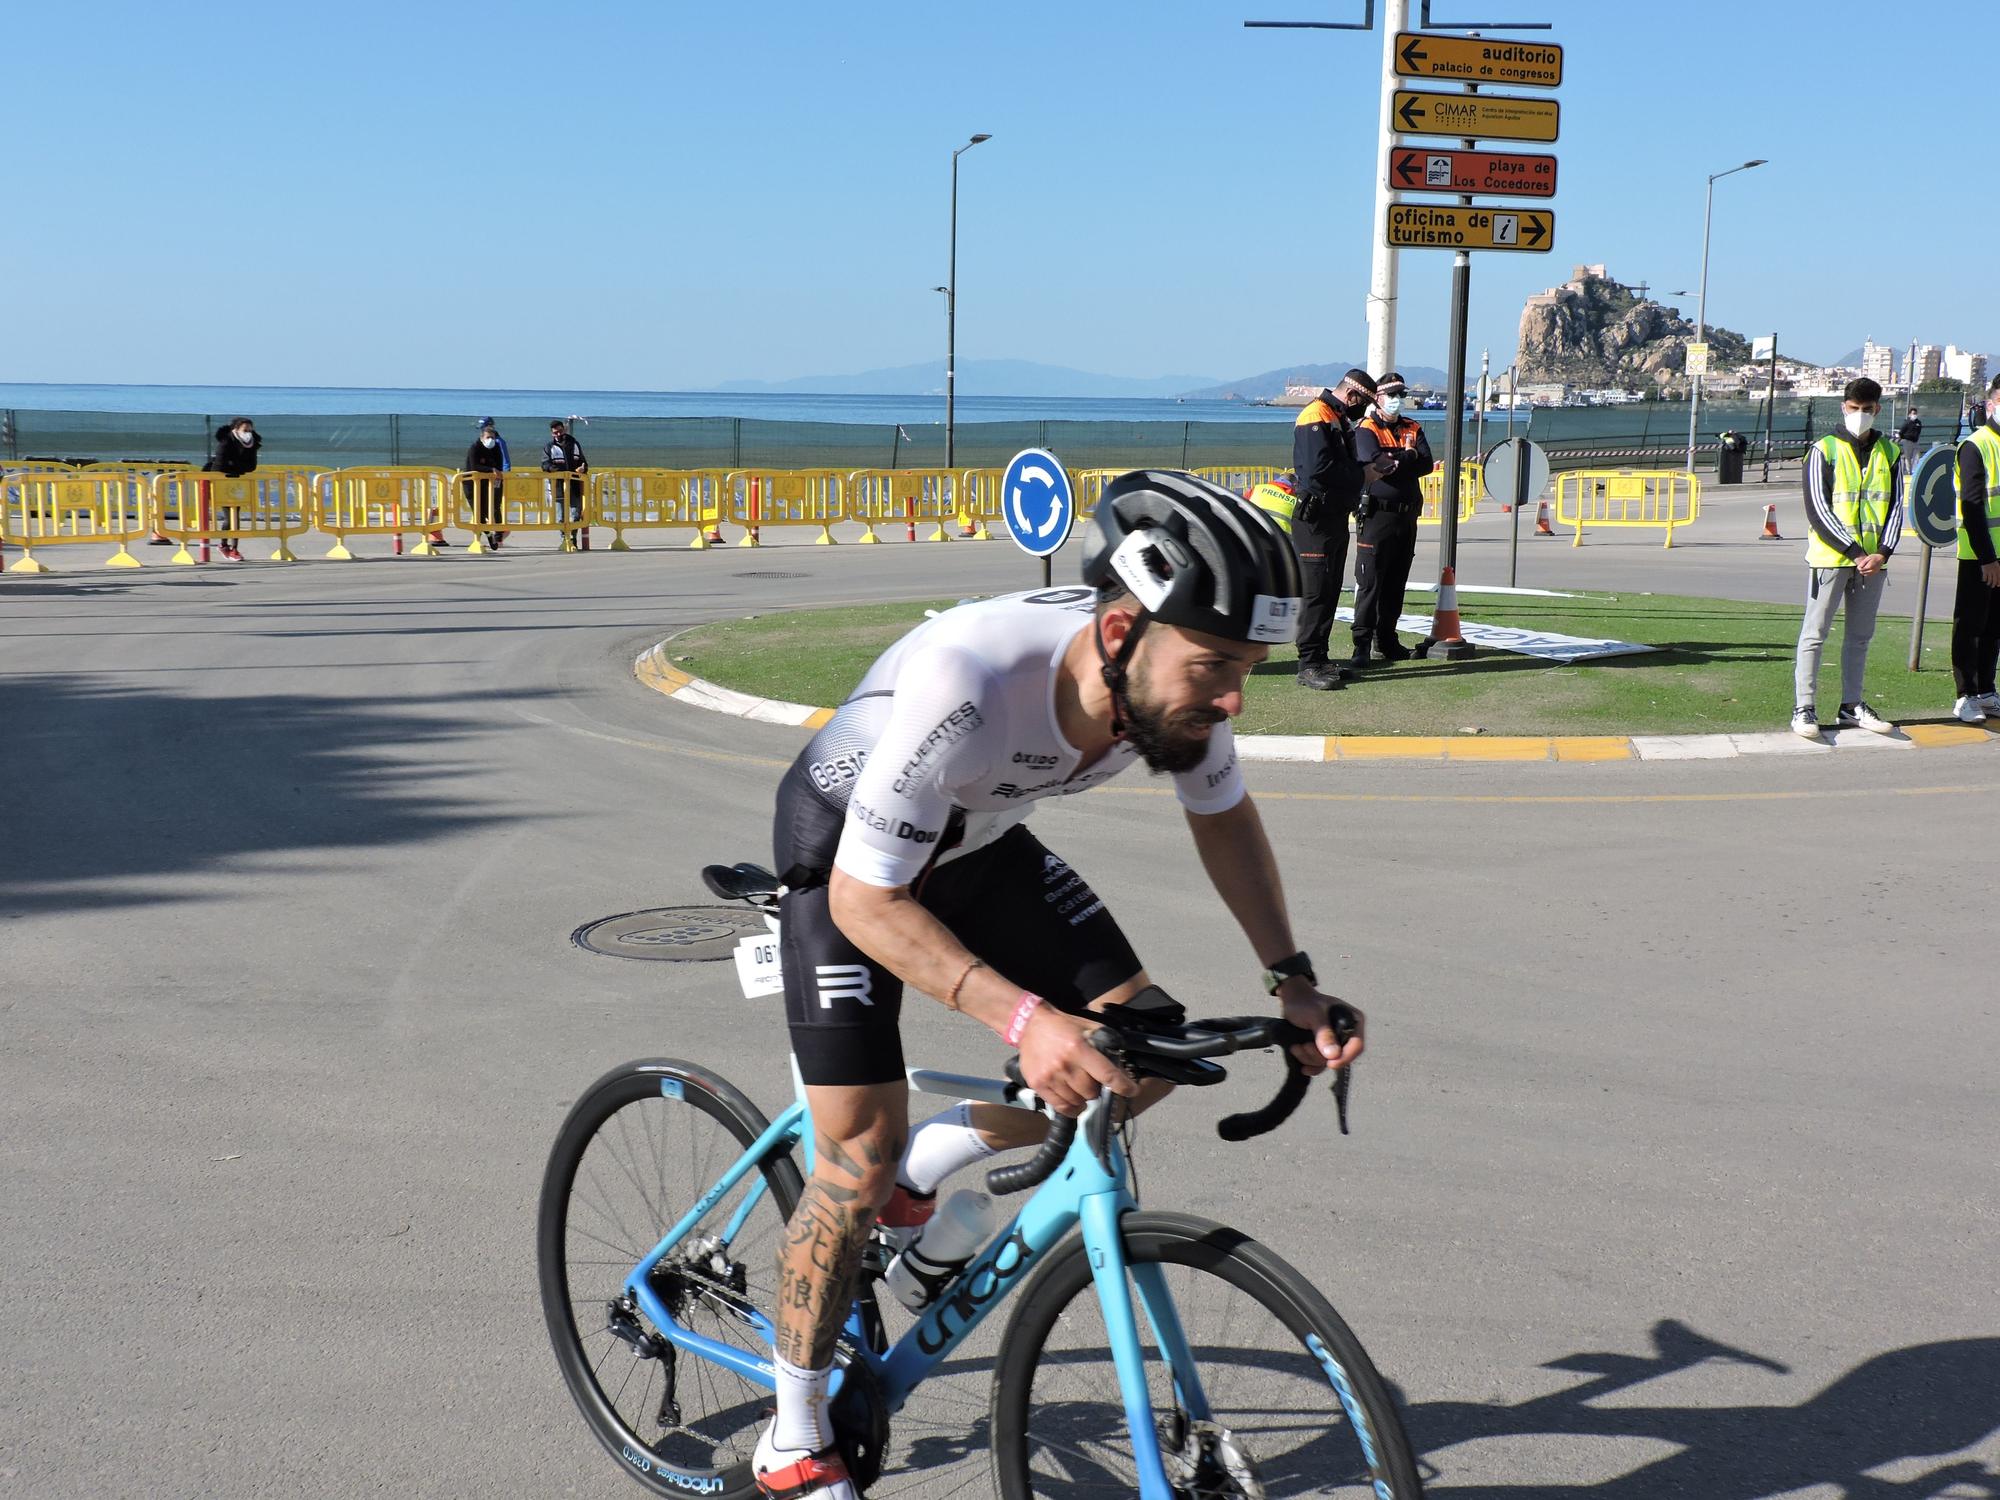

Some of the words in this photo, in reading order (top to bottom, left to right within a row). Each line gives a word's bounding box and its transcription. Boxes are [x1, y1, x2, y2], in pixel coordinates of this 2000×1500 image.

[1482, 47, 1556, 65] auditorio
[1432, 62, 1473, 74] palacio
[1480, 65, 1493, 75] de
[1500, 66, 1556, 81] congresos
[1434, 102, 1477, 117] CIMAR
[1489, 159, 1526, 174] playa
[1534, 162, 1550, 174] de
[1454, 174, 1476, 188] Los
[1484, 176, 1550, 191] Cocedores
[1393, 209, 1456, 227] oficina
[1468, 212, 1489, 228] de
[1393, 225, 1464, 244] turismo
[1262, 487, 1297, 506] PRENSA
